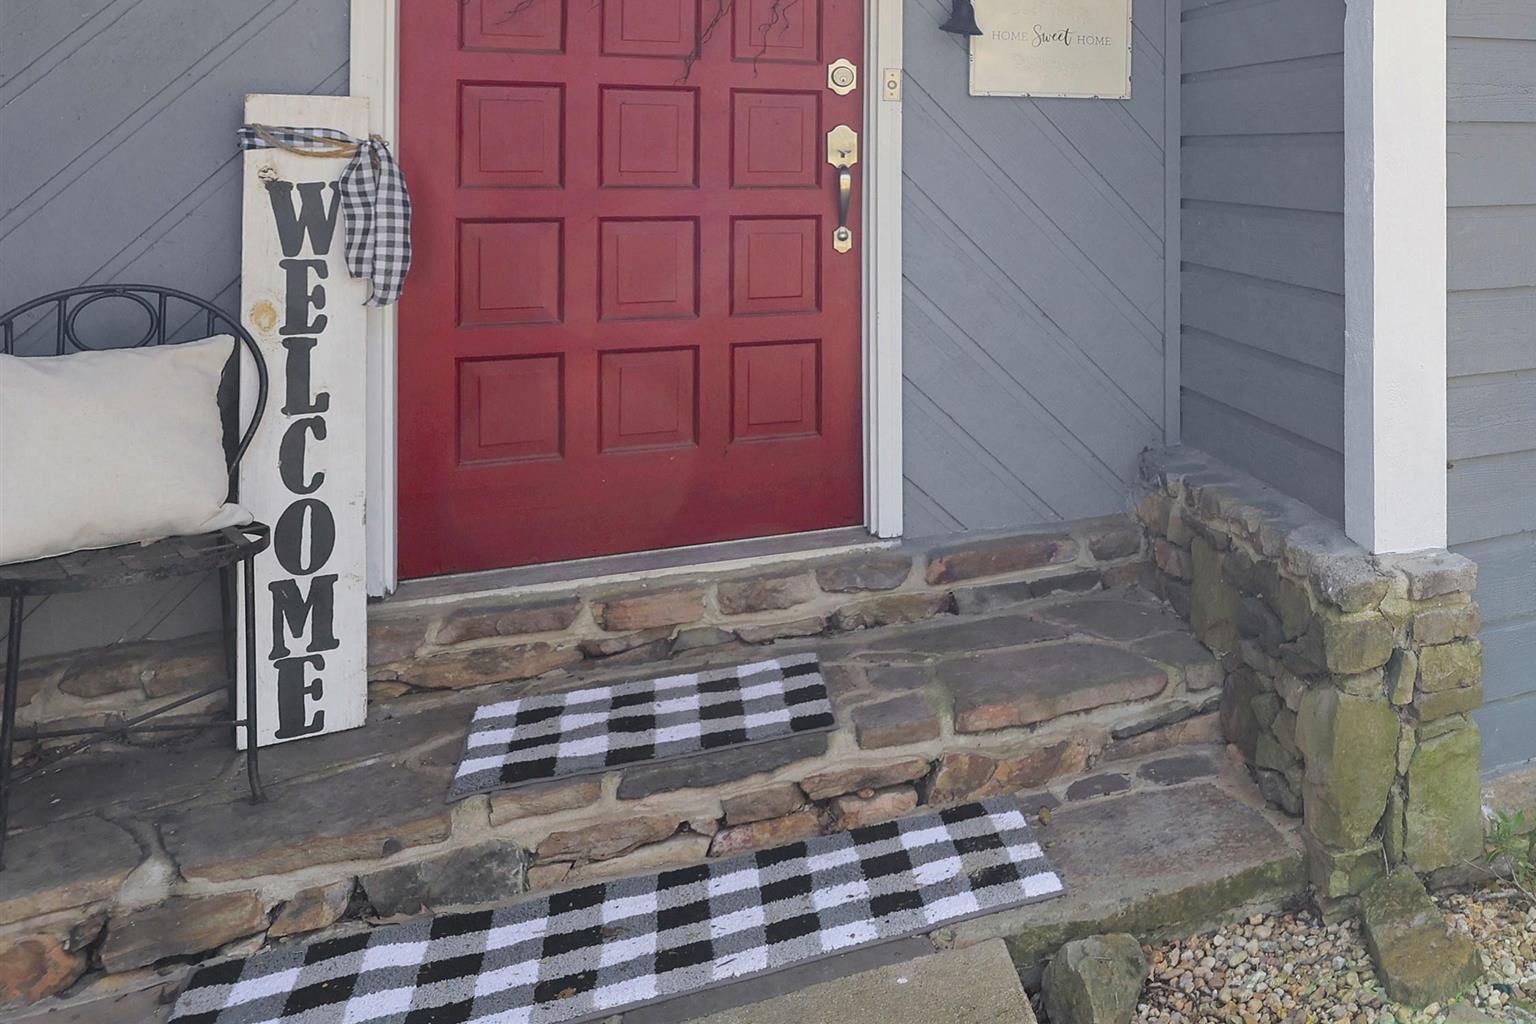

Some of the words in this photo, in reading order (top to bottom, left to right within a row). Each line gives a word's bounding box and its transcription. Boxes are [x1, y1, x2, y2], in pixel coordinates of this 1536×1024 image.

[992, 30, 1029, 41] HOME
[1031, 24, 1074, 48] Sweet
[1077, 35, 1112, 46] HOME
[264, 180, 341, 740] WELCOME
